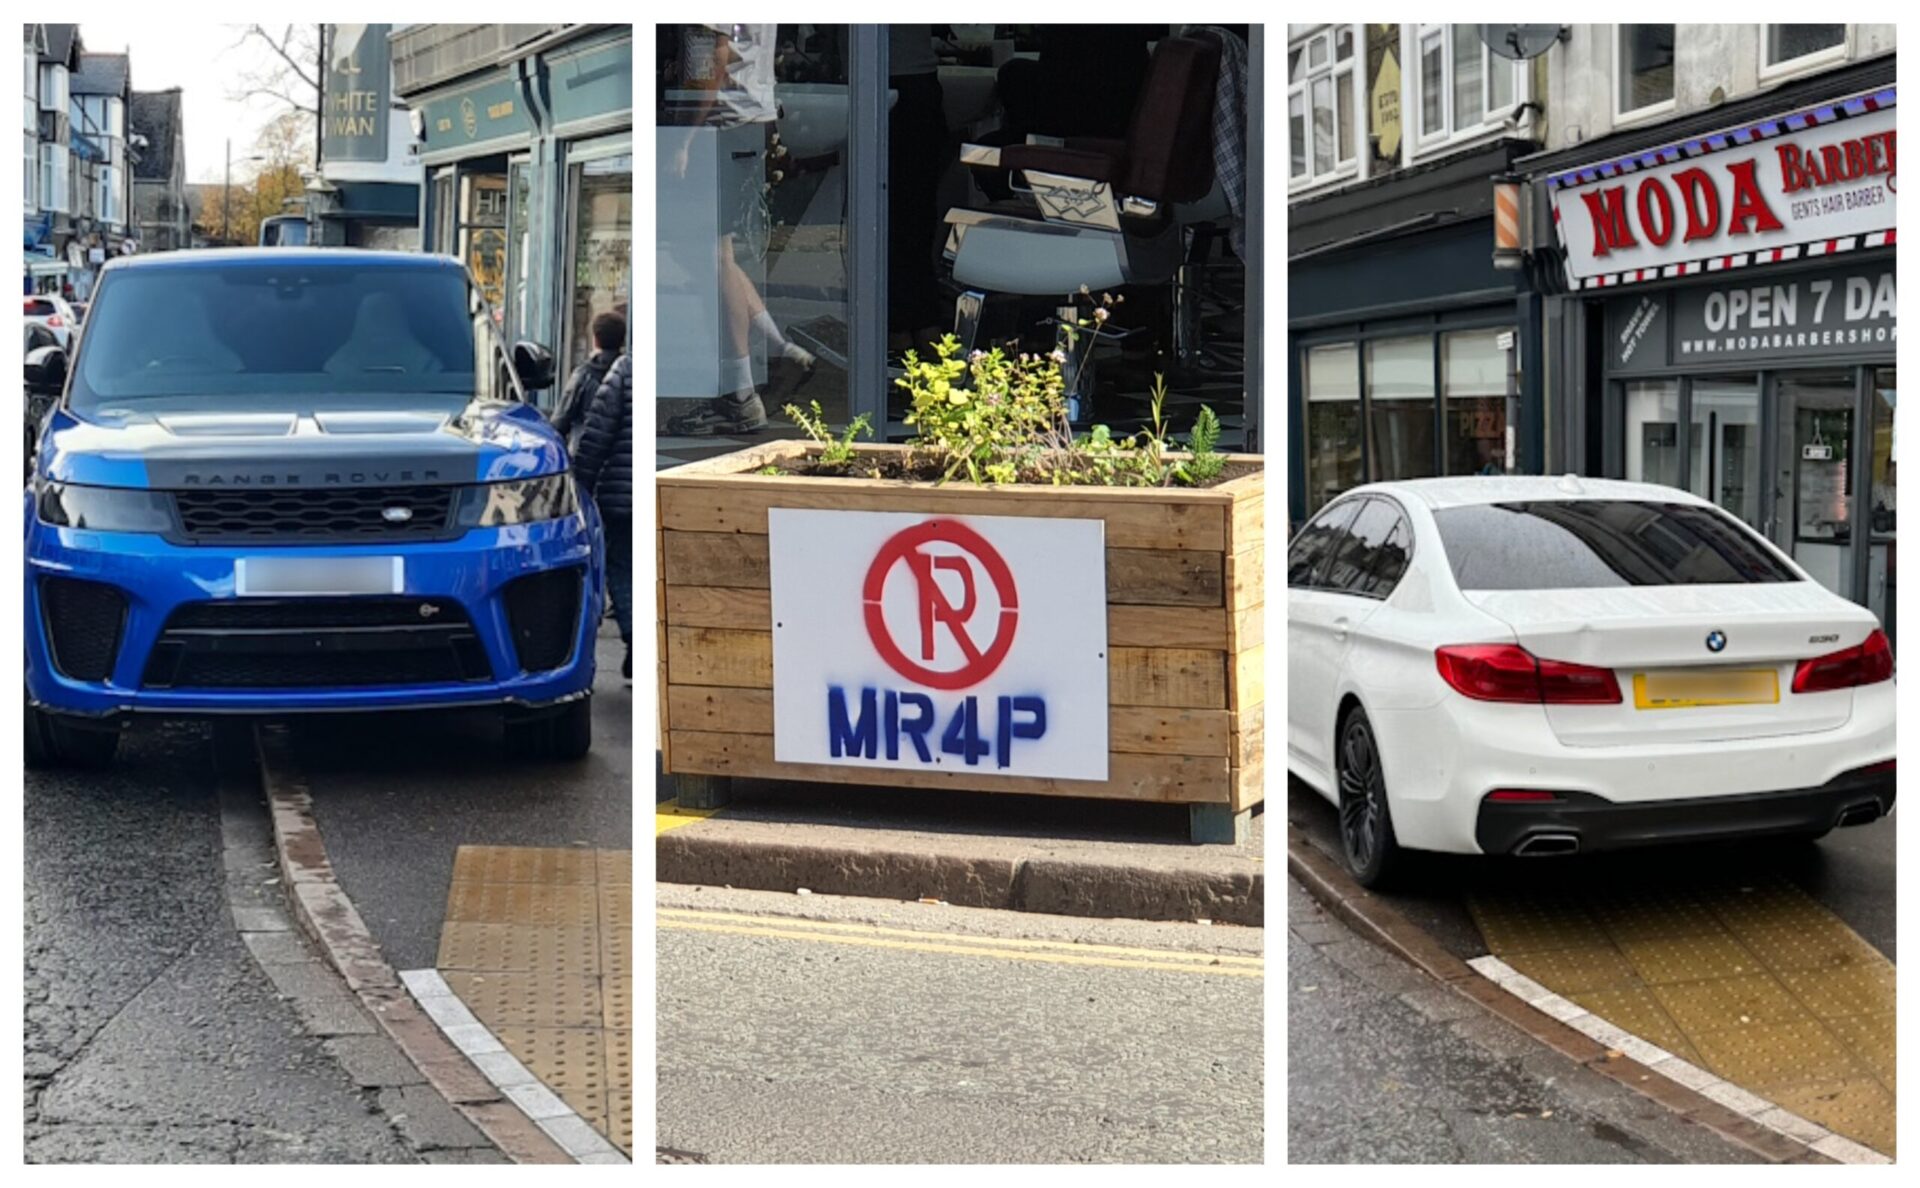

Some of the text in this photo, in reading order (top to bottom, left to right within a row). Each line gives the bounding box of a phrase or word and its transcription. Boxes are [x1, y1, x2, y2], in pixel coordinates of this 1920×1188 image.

[1579, 157, 1785, 258] MODA
[1791, 186, 1885, 221] GENTS HAIR BARBER
[1704, 283, 1798, 333] OPEN
[1810, 279, 1833, 324] 7
[1621, 336, 1637, 363] HOT
[185, 470, 440, 485] RANGE ROVER
[827, 686, 1048, 768] MR4P
